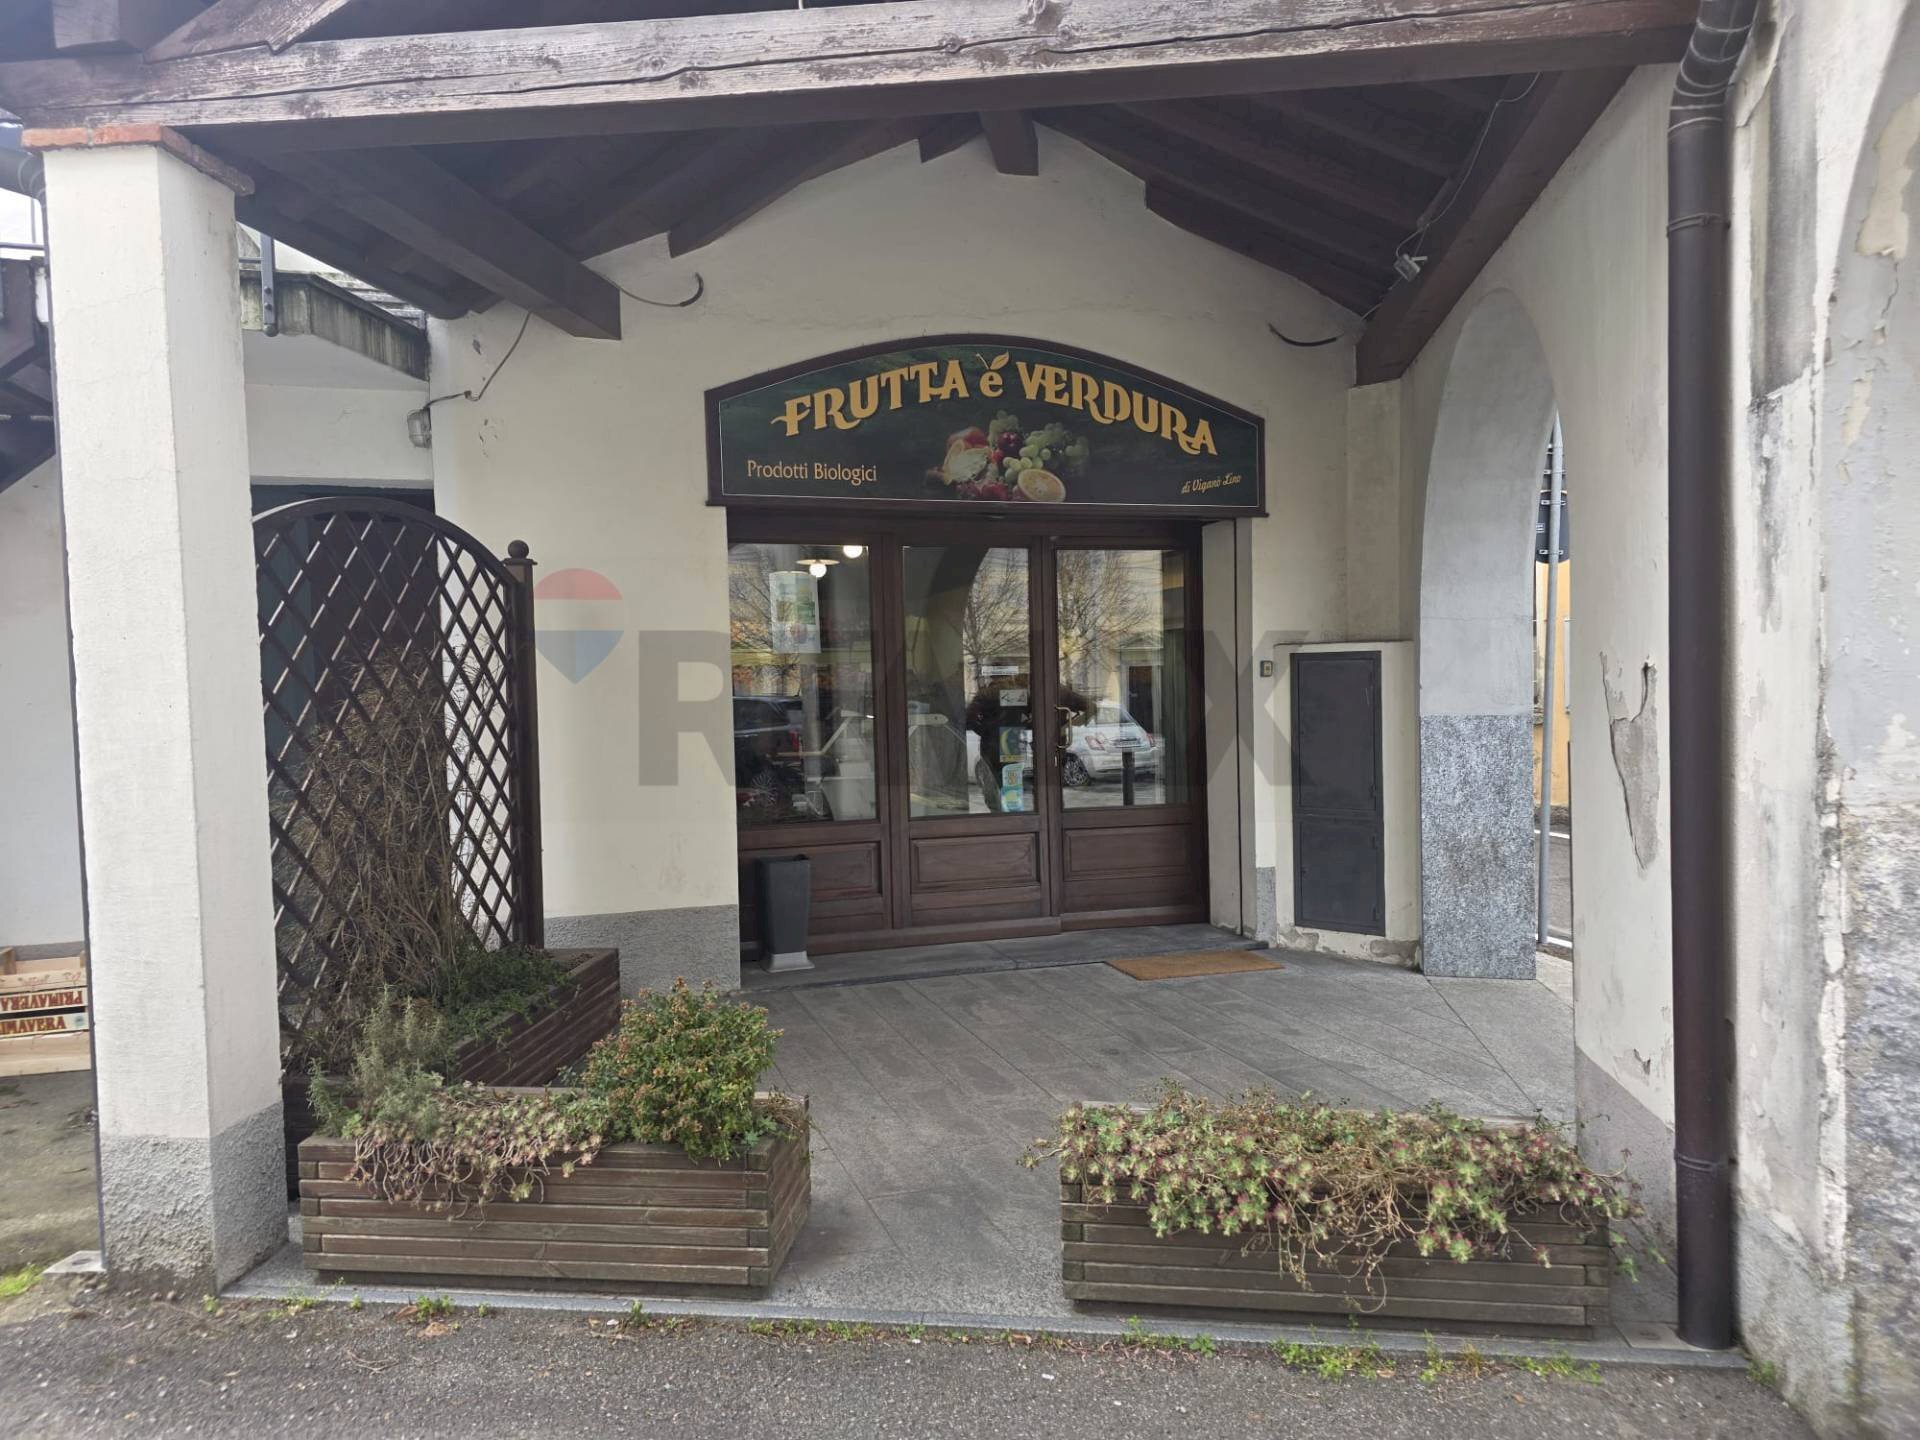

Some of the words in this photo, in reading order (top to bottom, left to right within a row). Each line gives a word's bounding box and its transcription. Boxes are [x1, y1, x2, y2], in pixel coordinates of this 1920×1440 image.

[770, 360, 969, 437] FRUTTA
[1016, 361, 1218, 455] VERDURA
[746, 459, 808, 480] Prodotti
[814, 463, 878, 486] Biologici
[1181, 481, 1191, 494] di
[1, 991, 83, 1012] PRIMAVERA
[0, 1016, 66, 1036] IMAVERA
